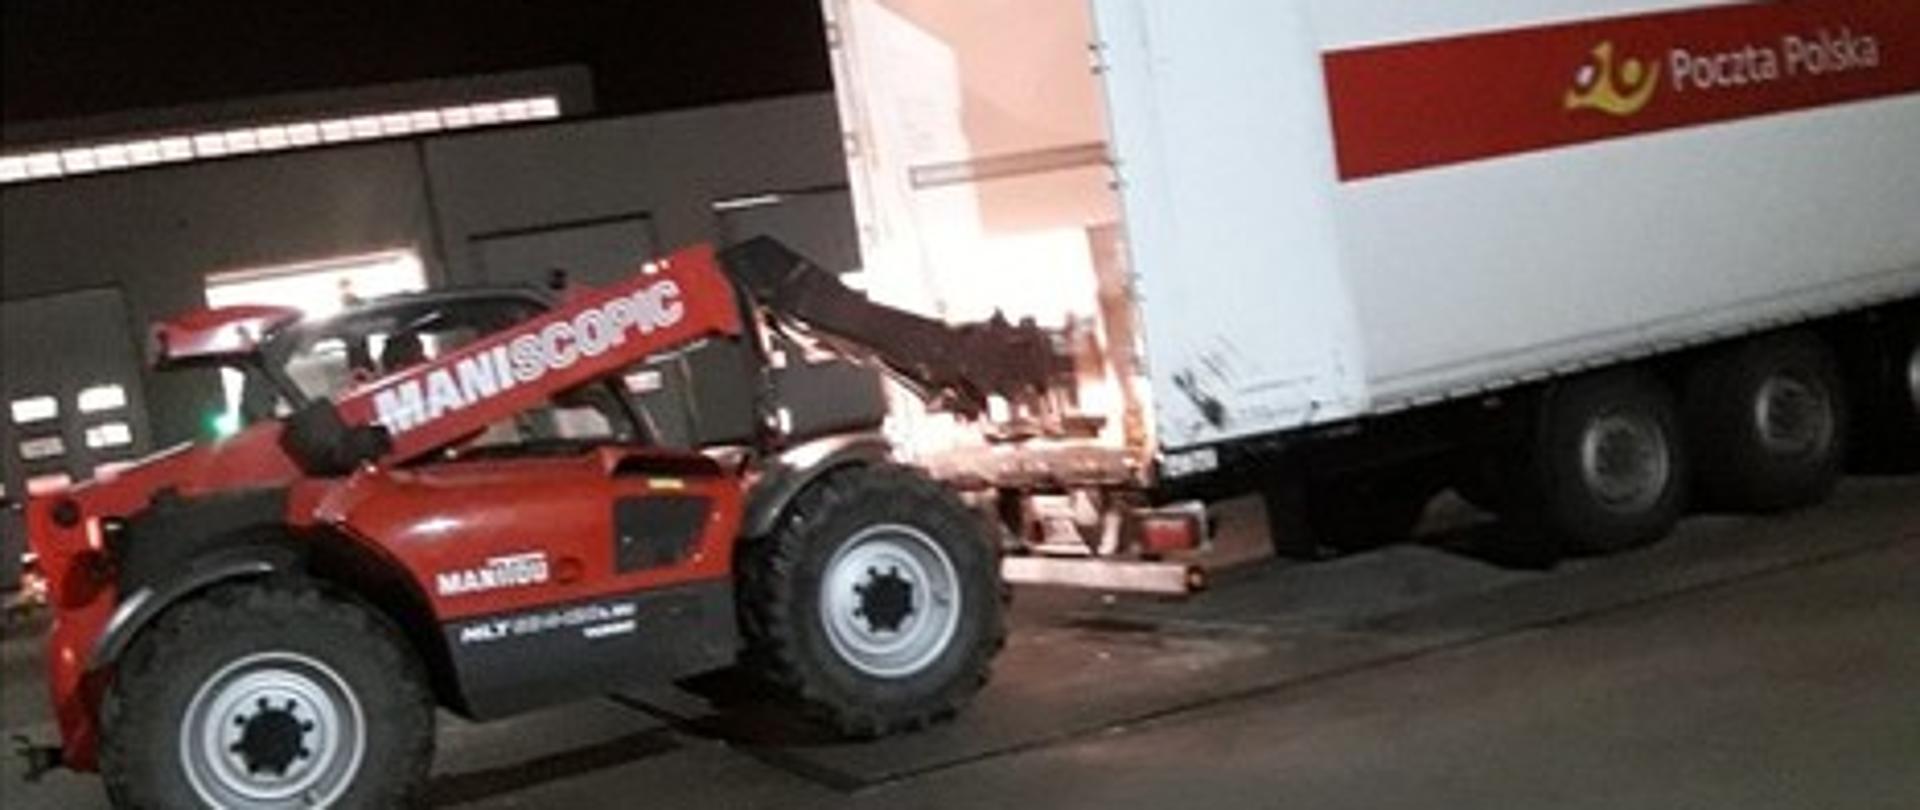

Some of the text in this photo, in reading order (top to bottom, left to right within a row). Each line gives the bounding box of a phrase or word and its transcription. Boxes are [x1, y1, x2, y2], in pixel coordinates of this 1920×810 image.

[1671, 30, 1879, 91] Poczta Polska
[374, 279, 684, 435] MANISCOPIC
